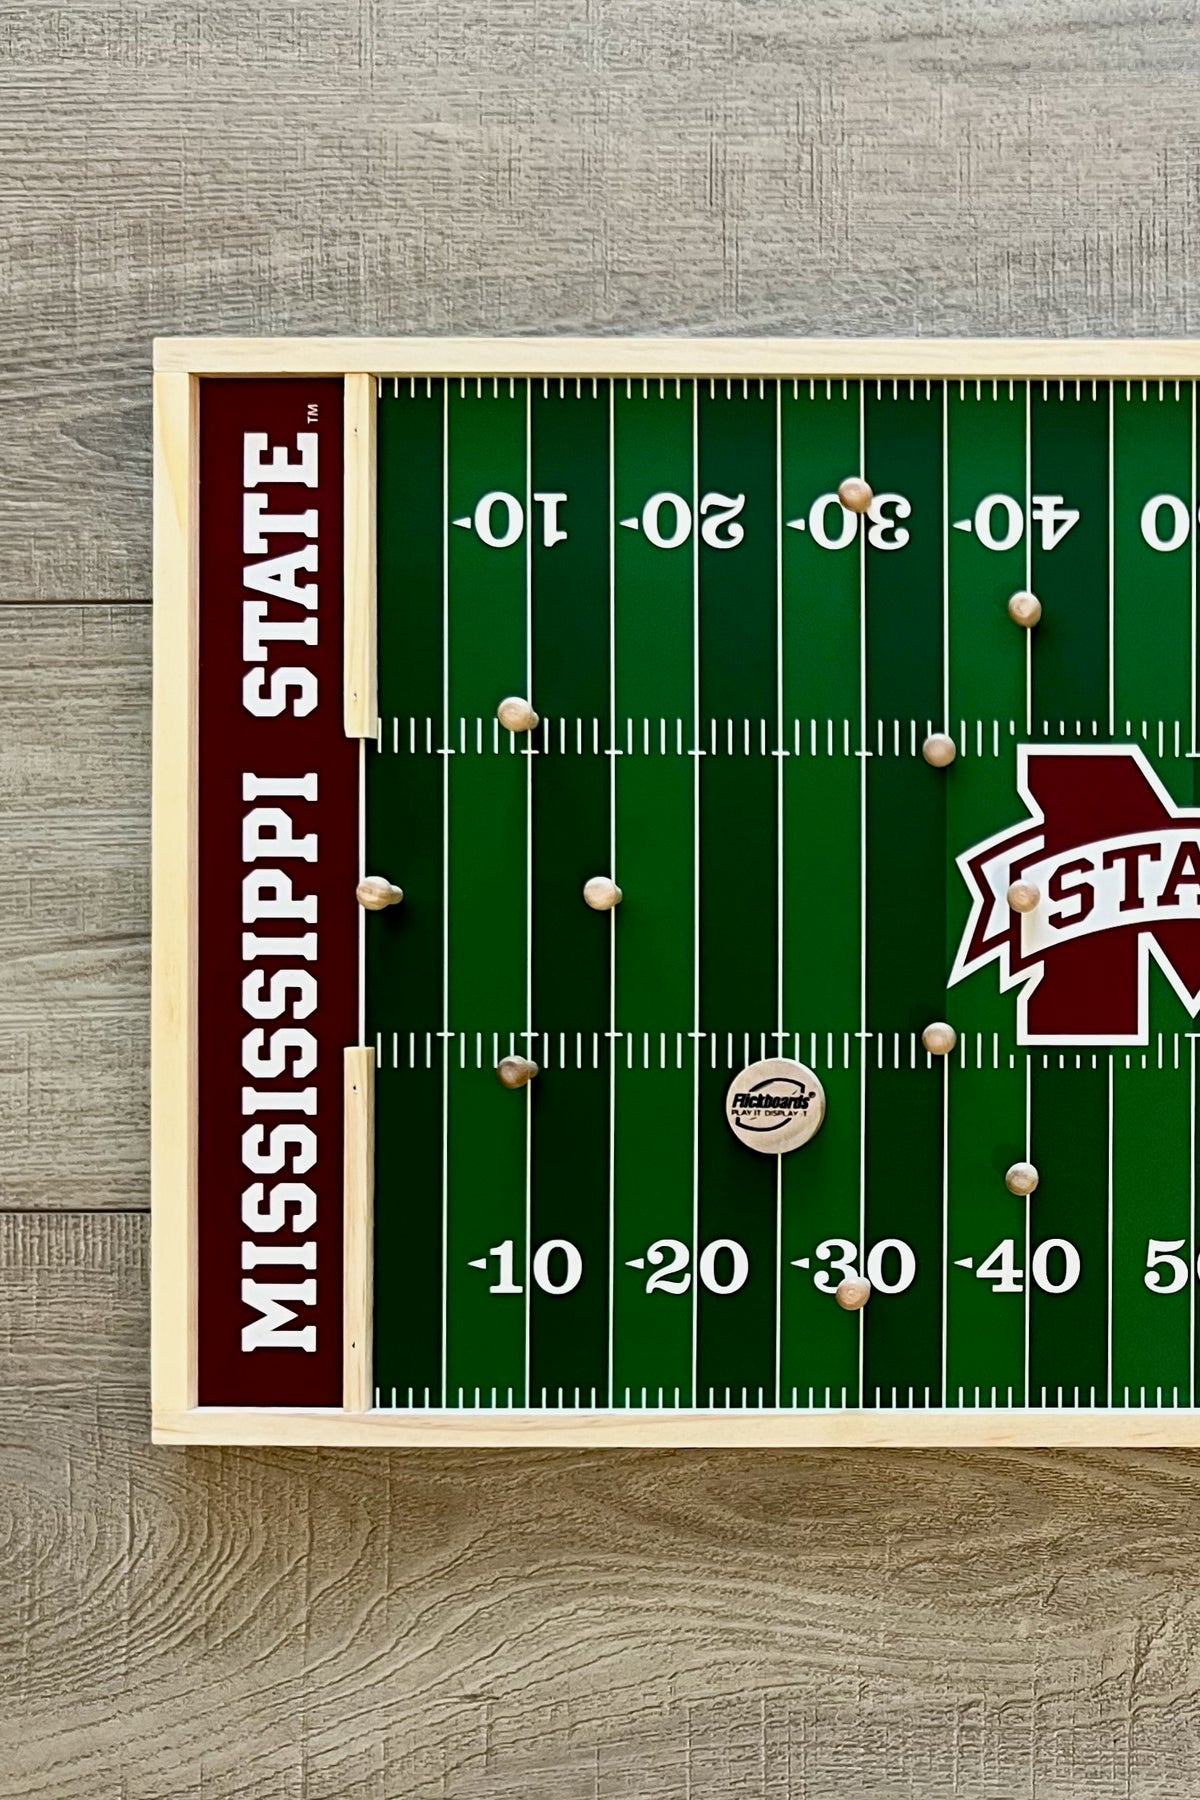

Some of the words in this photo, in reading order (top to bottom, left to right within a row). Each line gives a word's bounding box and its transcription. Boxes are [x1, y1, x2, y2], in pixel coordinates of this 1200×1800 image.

[475, 492, 567, 547] 10
[642, 492, 745, 549] 20
[809, 493, 911, 550] 30
[975, 493, 1080, 551] 40
[242, 432, 319, 718] STATE
[241, 771, 318, 1353] MISSISSIPPI
[489, 1239, 583, 1294] 10
[646, 1239, 749, 1294] 20
[814, 1239, 916, 1294] 30
[976, 1239, 1081, 1294] 40
